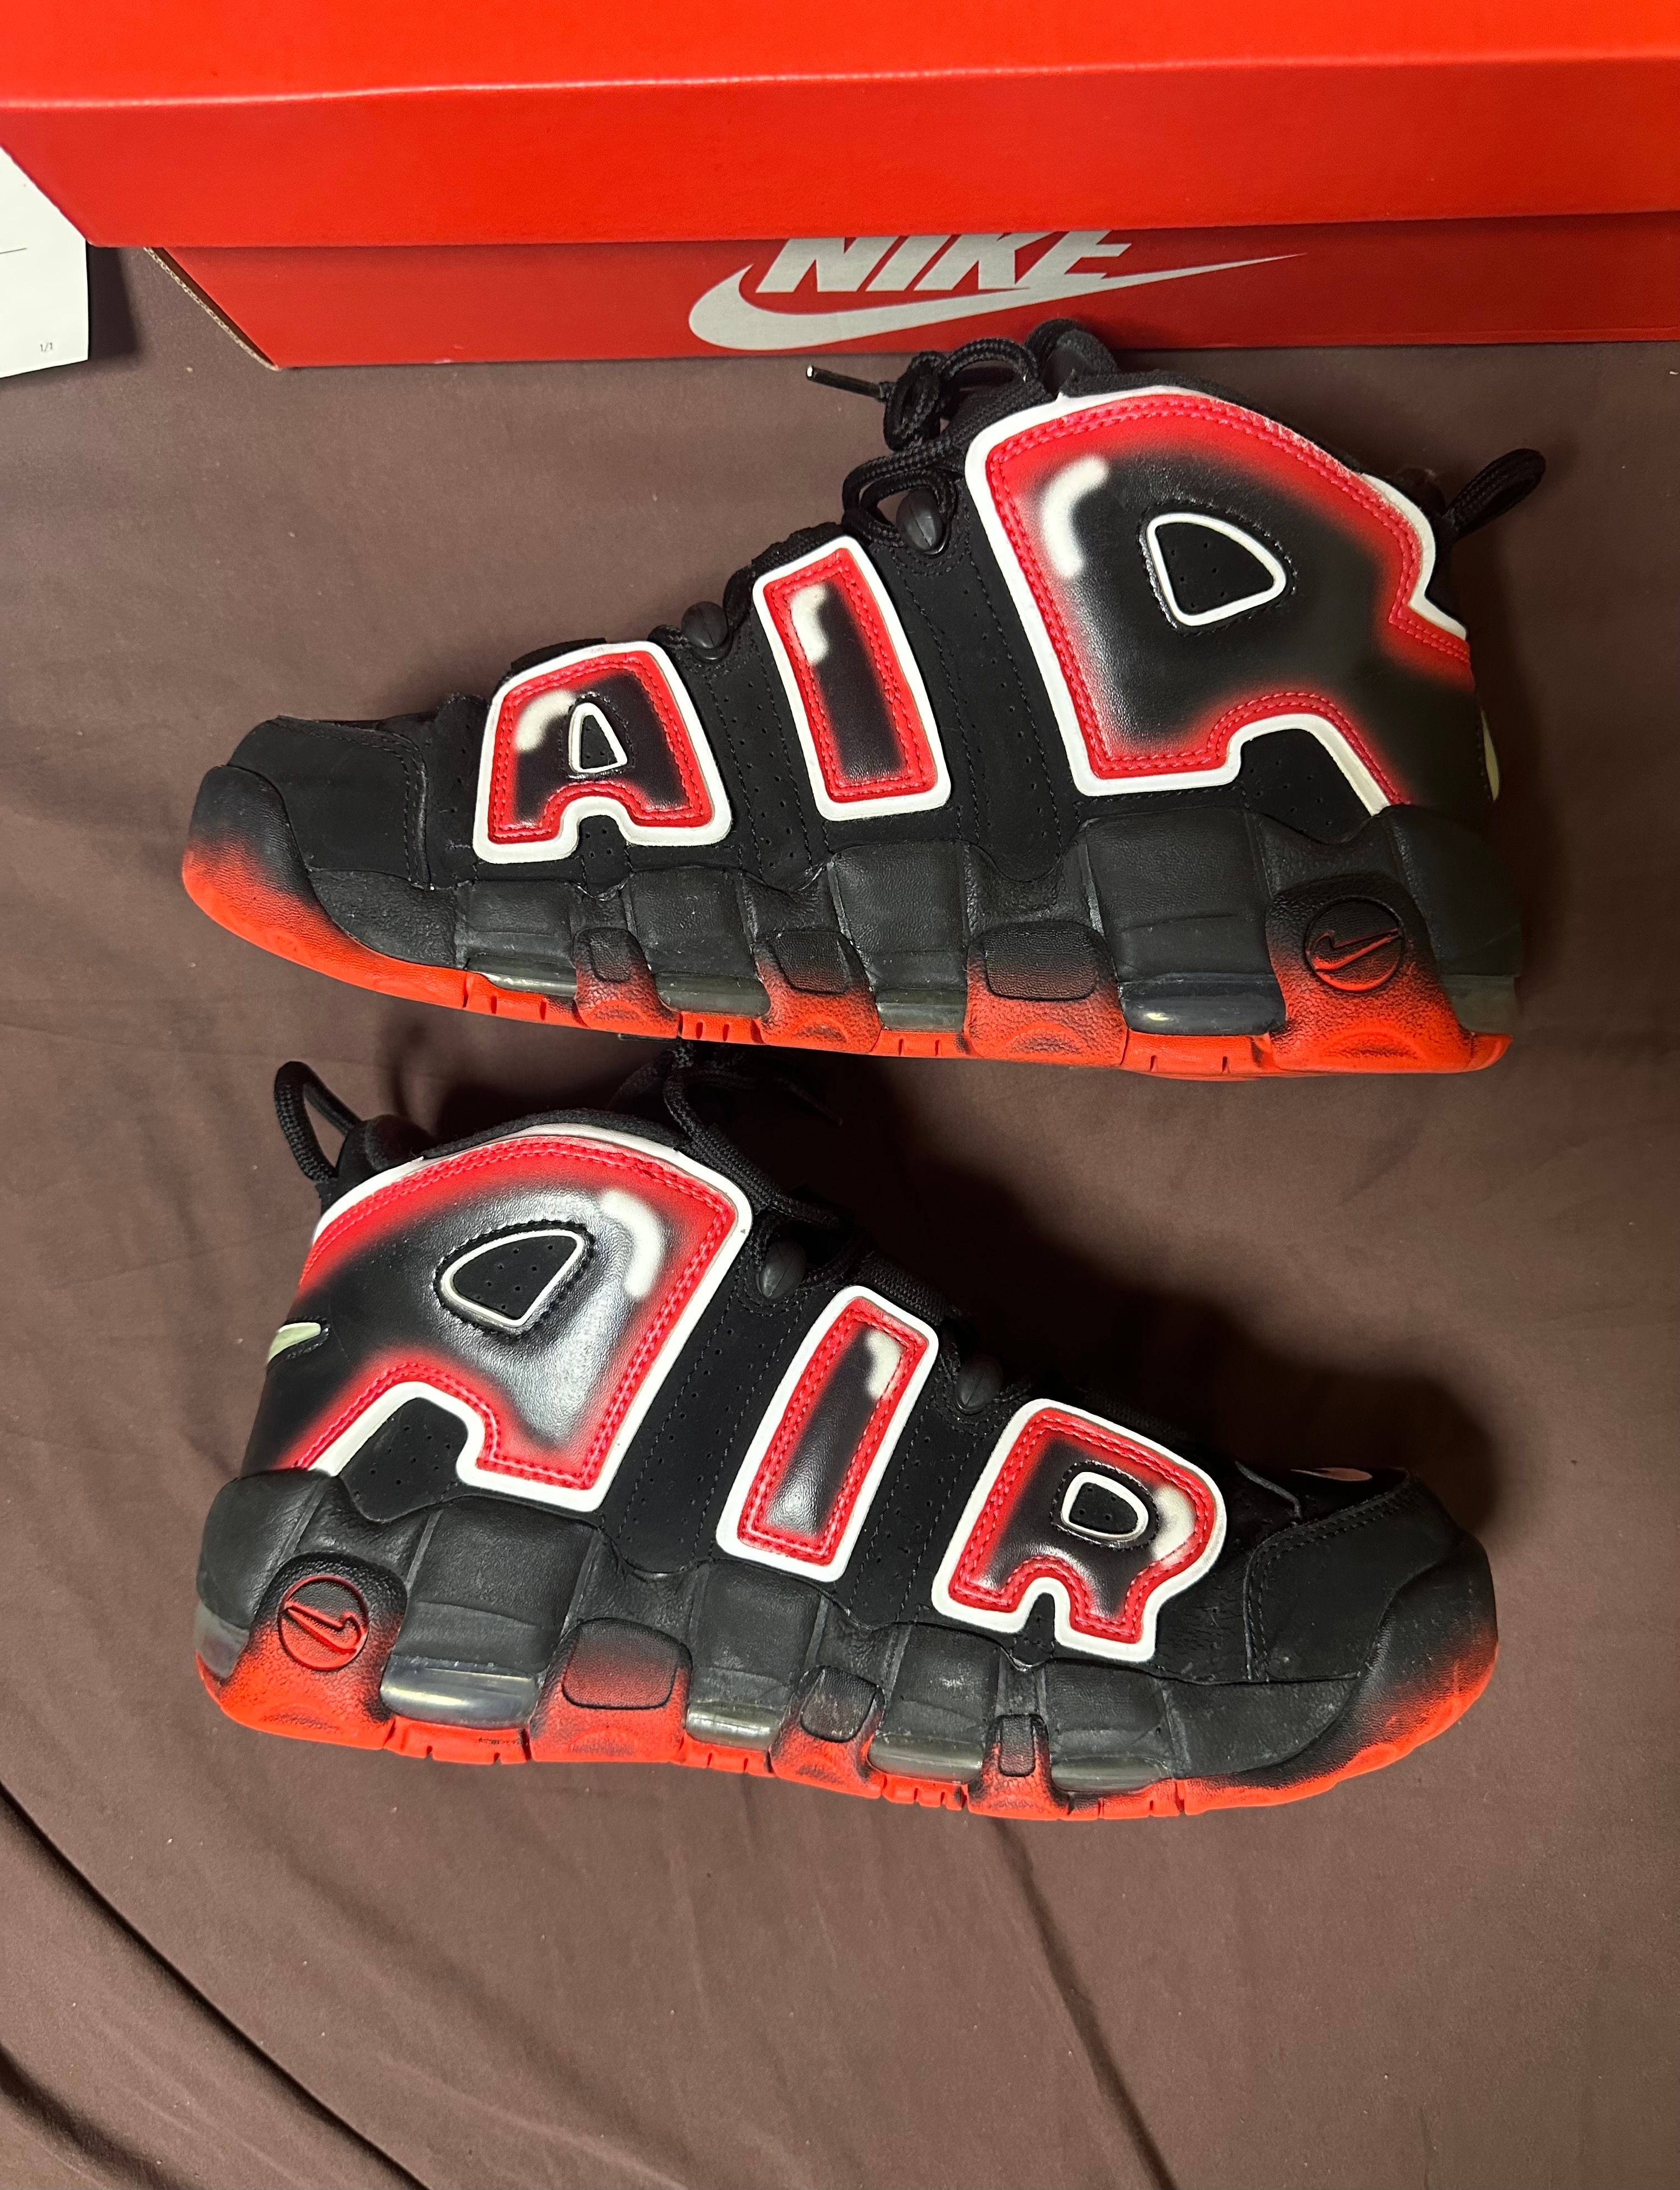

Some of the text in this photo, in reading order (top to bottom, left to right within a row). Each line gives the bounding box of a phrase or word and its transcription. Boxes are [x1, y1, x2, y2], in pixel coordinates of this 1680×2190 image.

[40, 342, 53, 352] 1/1
[756, 230, 1131, 292] NIKE
[472, 385, 1475, 864] AIR
[266, 1123, 1228, 1662] AIR
